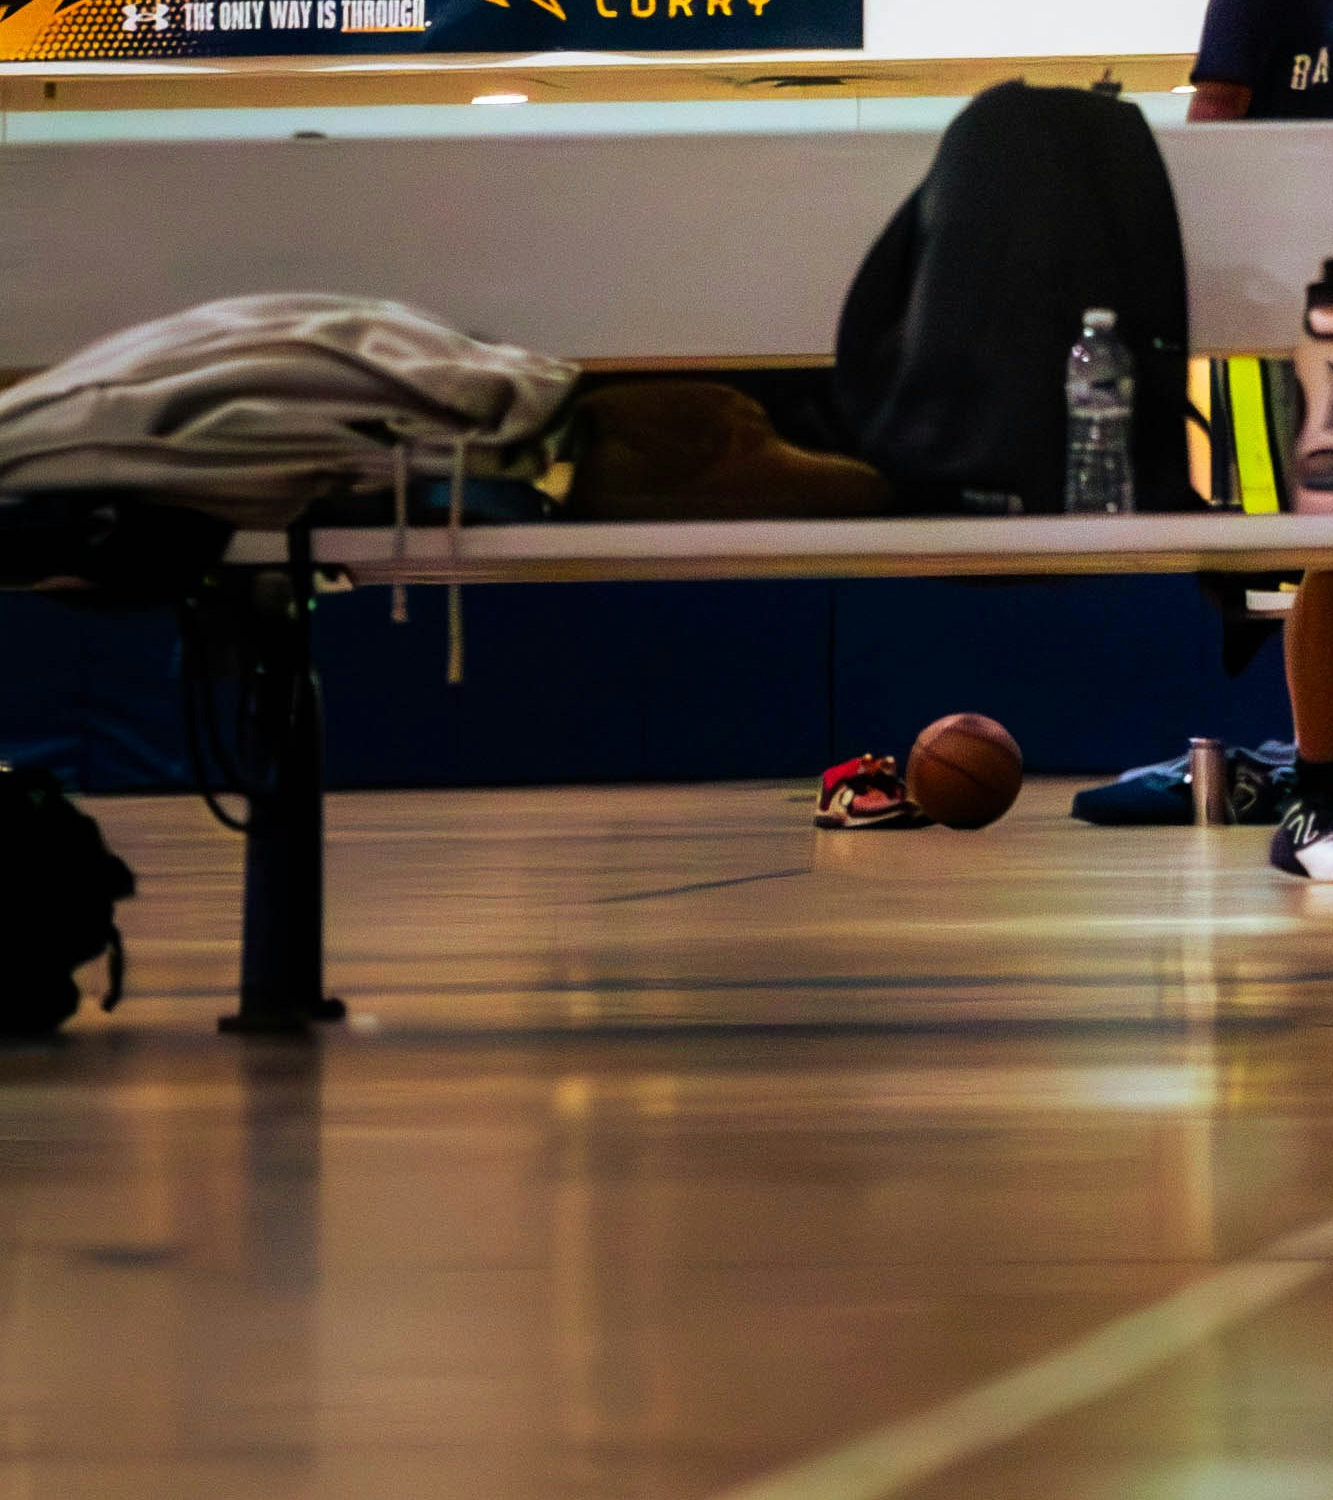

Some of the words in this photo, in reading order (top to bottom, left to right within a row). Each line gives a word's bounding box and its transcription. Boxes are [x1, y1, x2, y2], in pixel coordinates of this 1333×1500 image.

[184, 2, 215, 31] THE
[219, 0, 265, 31] ONLY
[269, 0, 313, 30] WAY
[317, 0, 338, 29] IS
